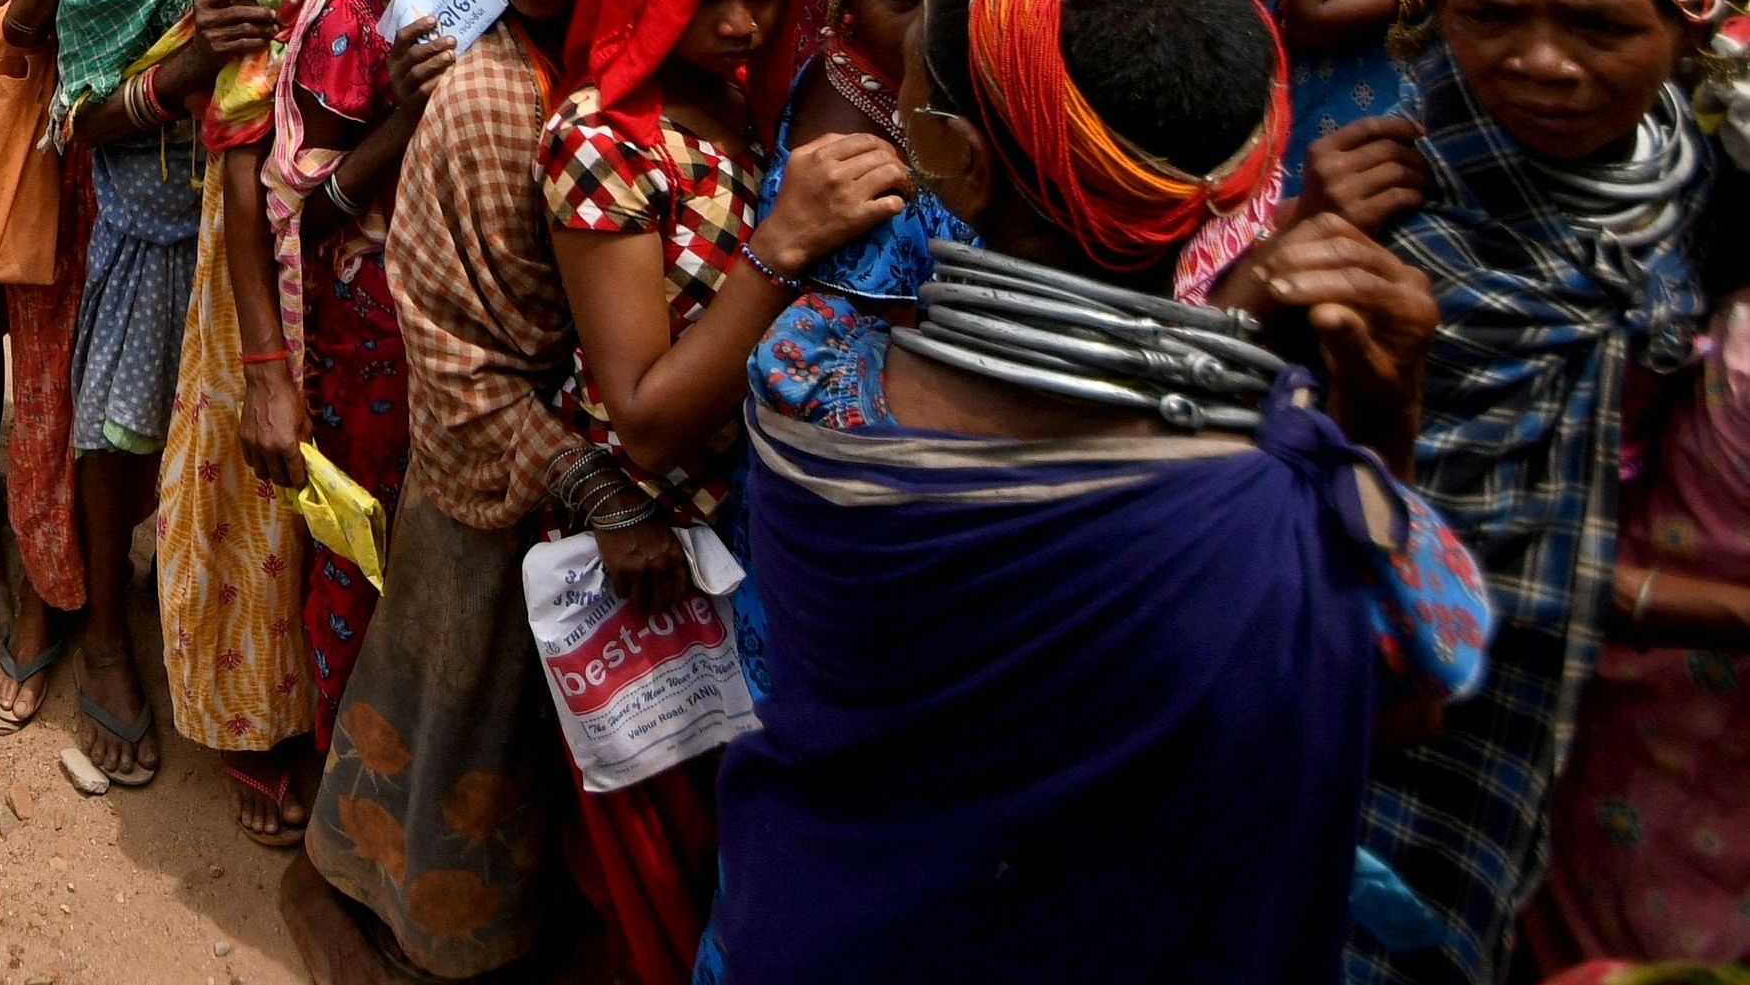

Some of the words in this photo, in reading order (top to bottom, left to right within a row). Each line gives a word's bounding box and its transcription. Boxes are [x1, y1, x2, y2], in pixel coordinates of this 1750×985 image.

[563, 623, 586, 647] THE
[584, 596, 616, 629] MULTI
[666, 673, 692, 688] Wear
[658, 705, 688, 725] Road,
